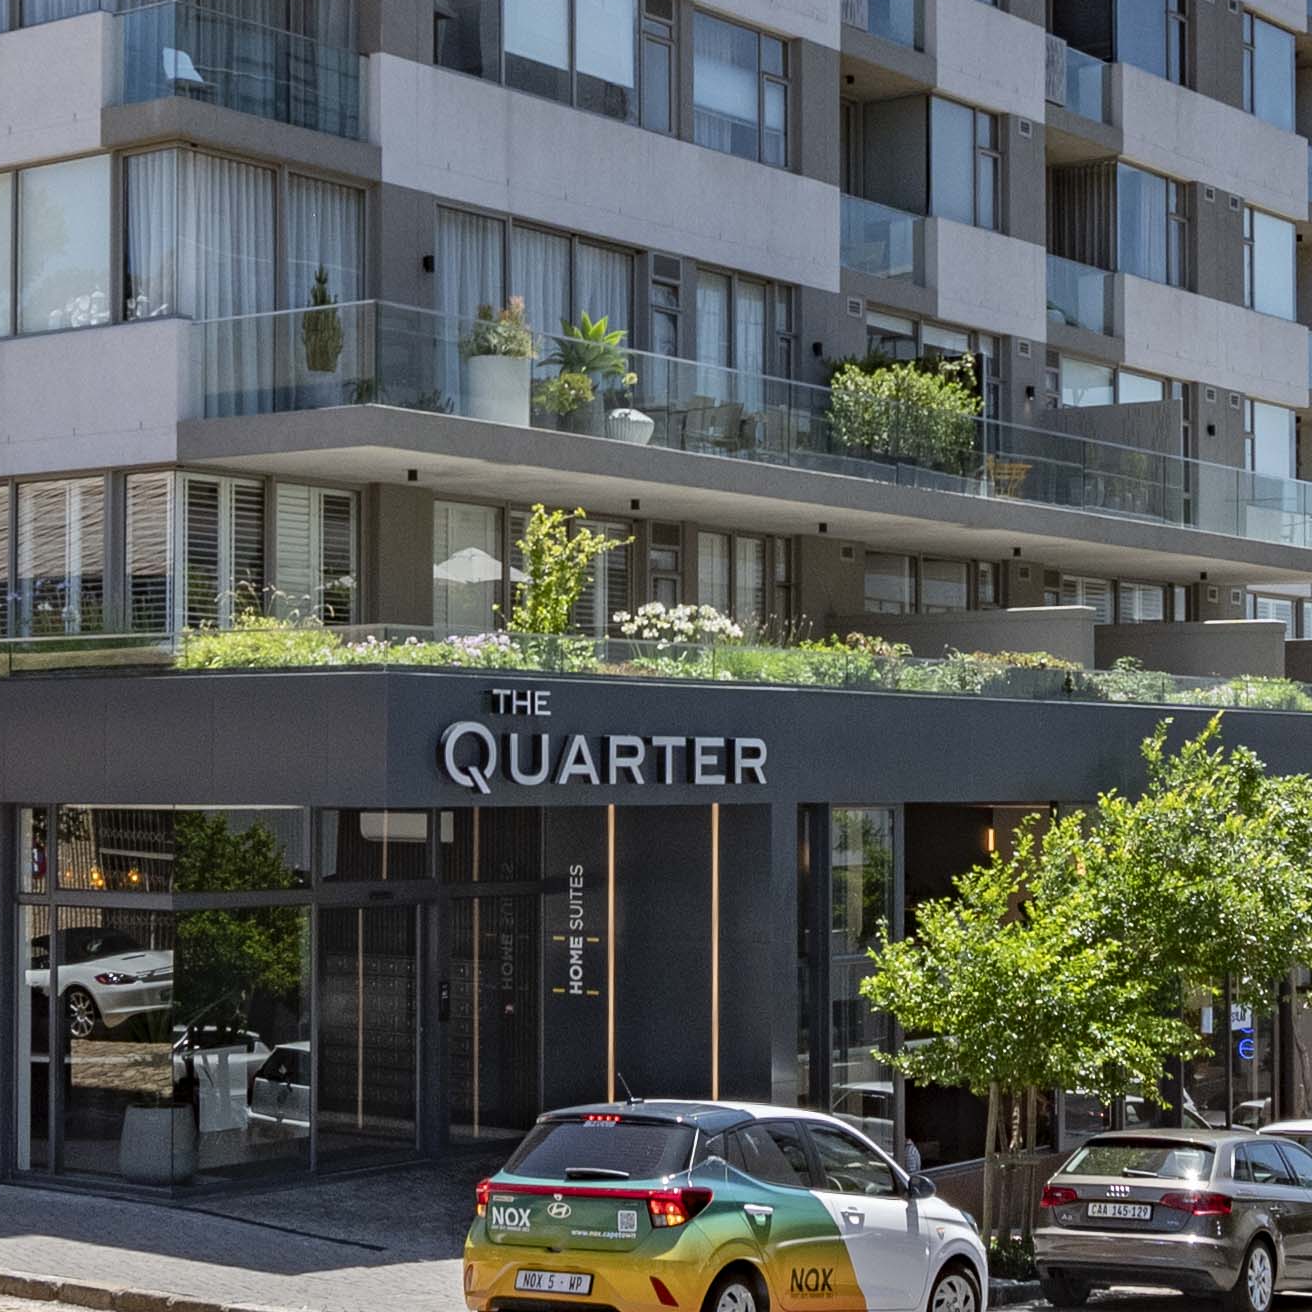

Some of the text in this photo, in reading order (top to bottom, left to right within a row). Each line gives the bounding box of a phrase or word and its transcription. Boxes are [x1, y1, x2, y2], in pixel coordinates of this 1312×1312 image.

[491, 688, 552, 716] THE
[441, 721, 768, 794] QUARTER
[569, 864, 583, 995] HOME SUITES
[492, 1206, 531, 1227] NOX
[1091, 1204, 1108, 1216] CAA
[523, 1272, 542, 1288] NOX
[548, 1274, 555, 1289] 5
[568, 1276, 583, 1291] WP
[790, 1268, 834, 1292] NOX
